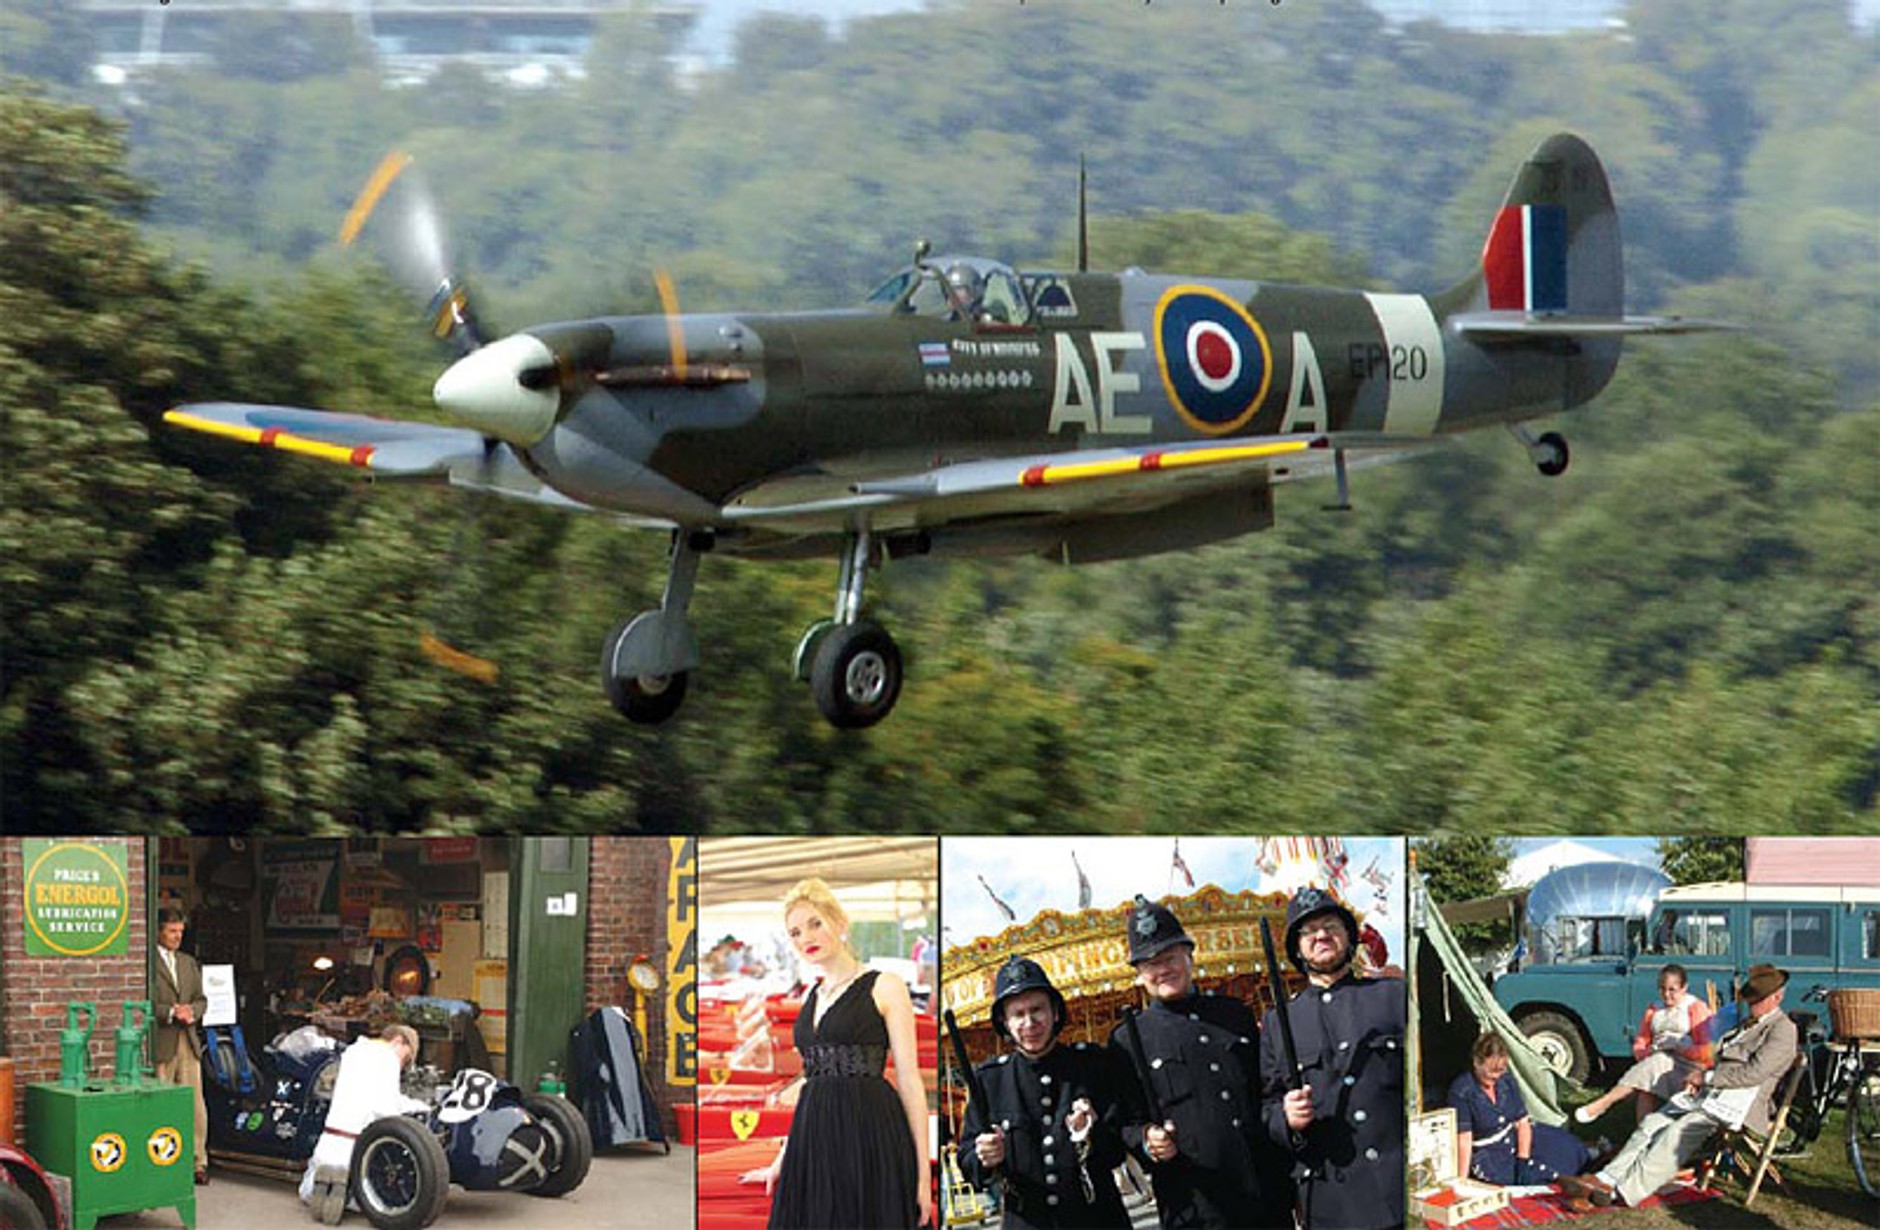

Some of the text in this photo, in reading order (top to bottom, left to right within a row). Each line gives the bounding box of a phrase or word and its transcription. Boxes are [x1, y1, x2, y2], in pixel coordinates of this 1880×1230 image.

[1048, 332, 1153, 433] AE
[1280, 331, 1328, 433] A
[35, 883, 121, 906] ENERGOL
[49, 922, 105, 933] SERVICE
